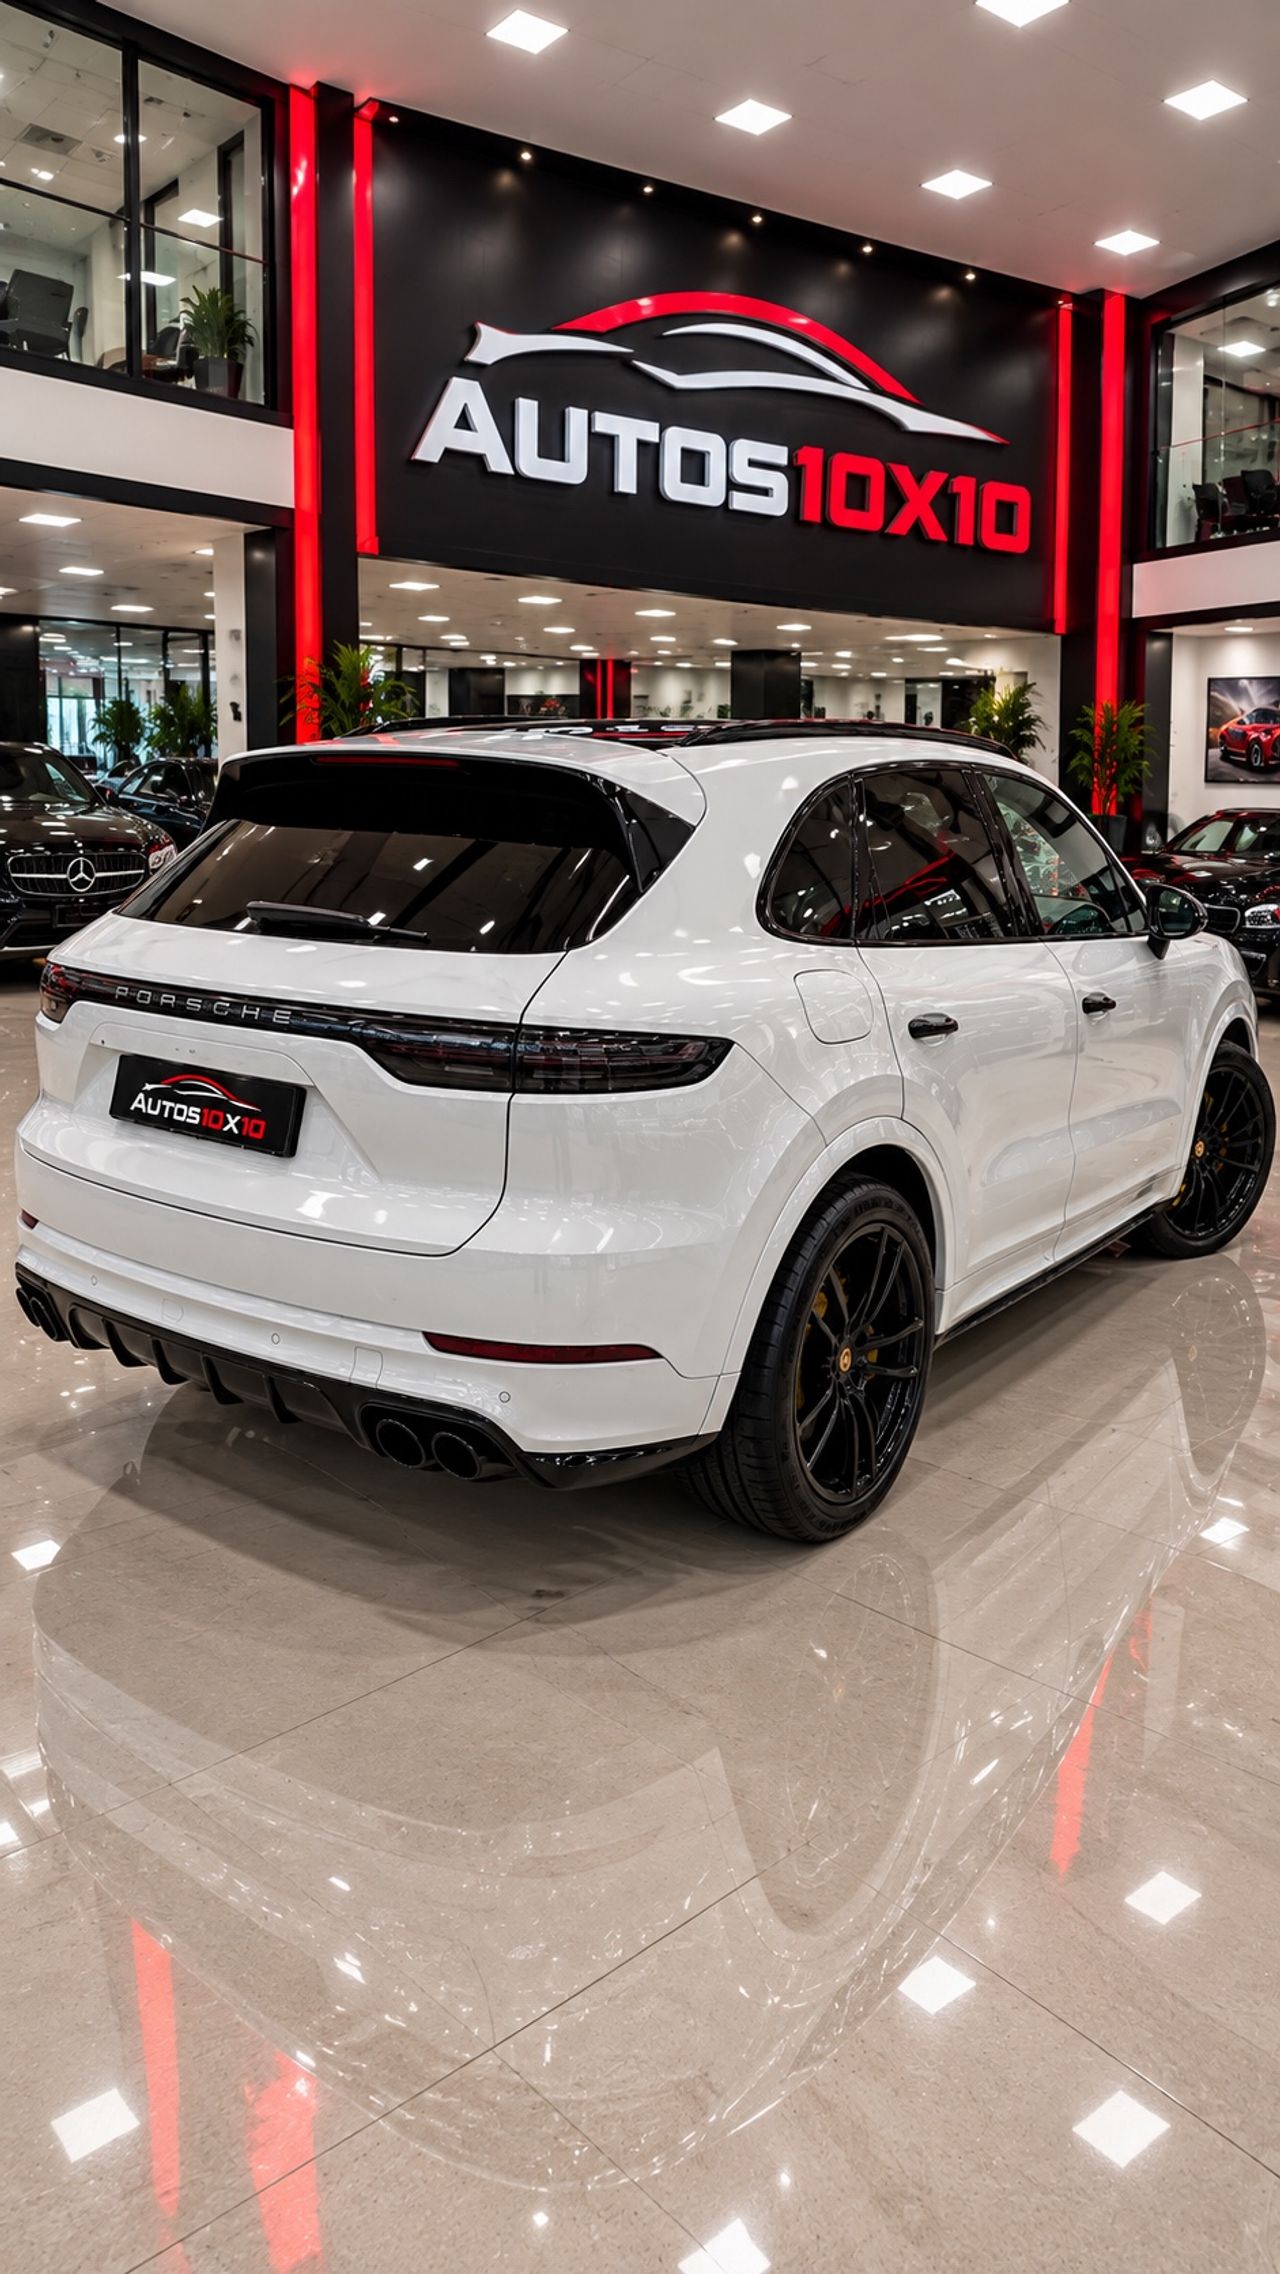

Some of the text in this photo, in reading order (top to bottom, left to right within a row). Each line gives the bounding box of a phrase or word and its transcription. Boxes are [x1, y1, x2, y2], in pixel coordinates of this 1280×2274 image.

[410, 376, 1031, 554] AUTOS10X10
[115, 986, 292, 1024] PORSCHE
[130, 1092, 267, 1140] AUTOS10X10
